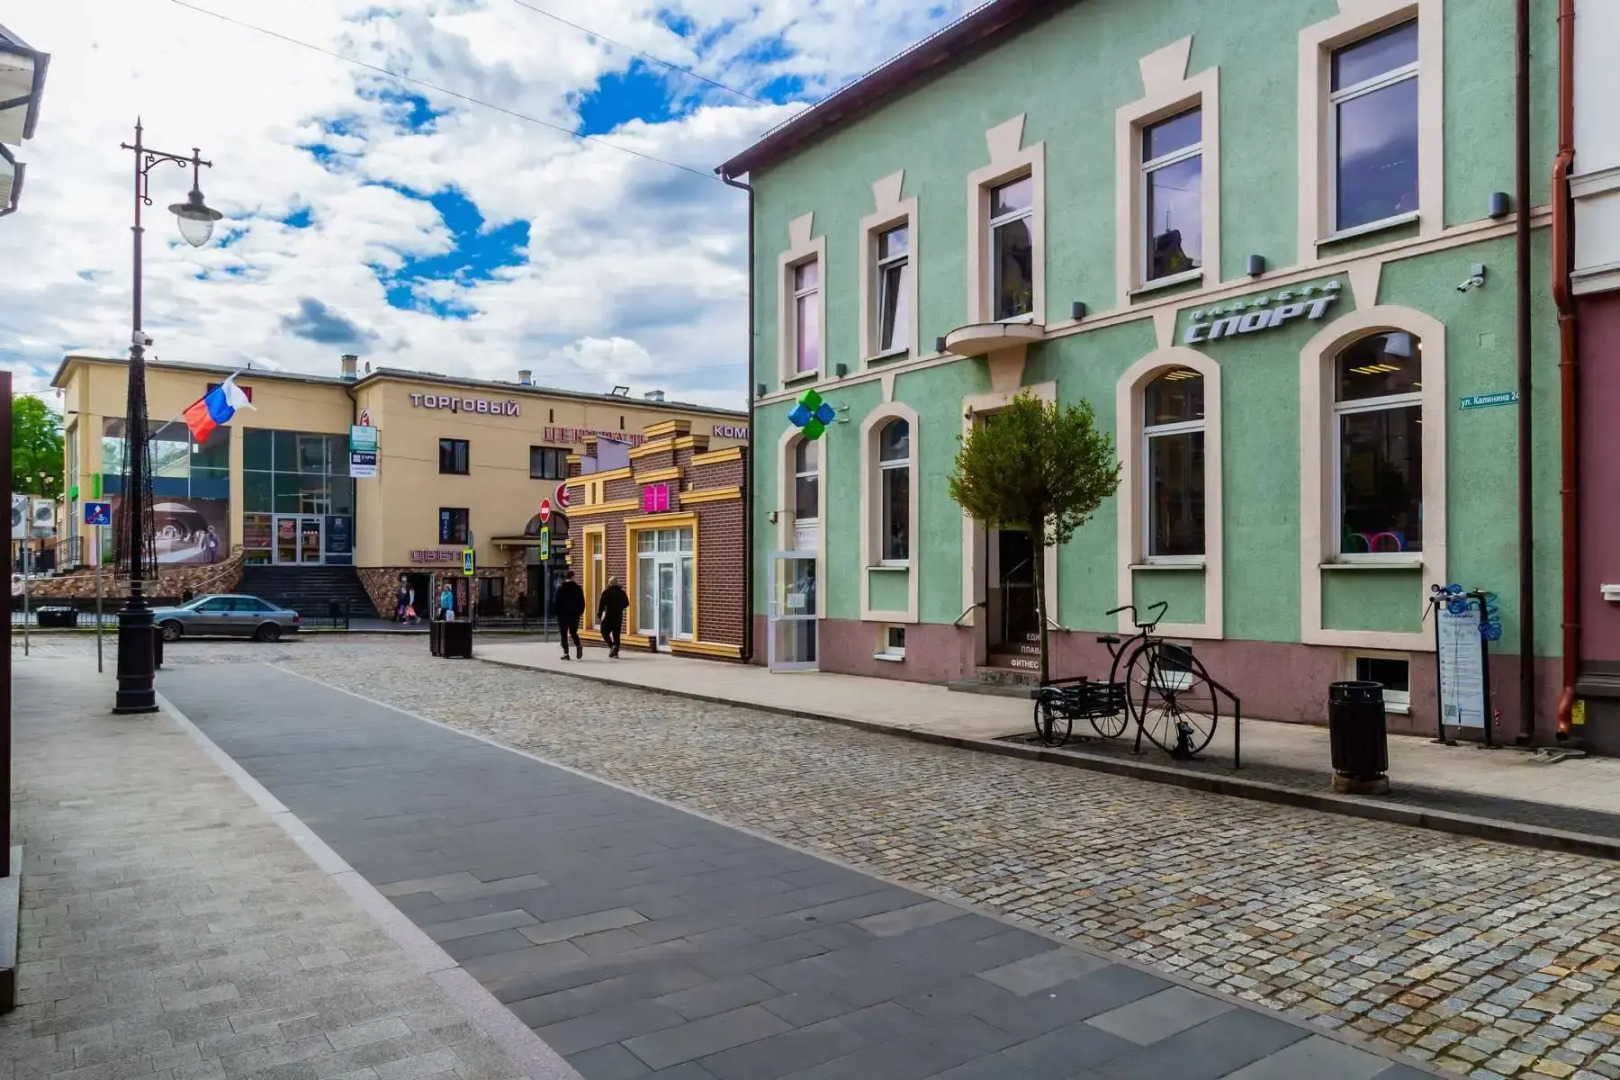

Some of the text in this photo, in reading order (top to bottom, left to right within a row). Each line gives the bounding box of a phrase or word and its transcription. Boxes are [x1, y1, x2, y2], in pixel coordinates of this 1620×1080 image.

[1190, 280, 1341, 320] ПЛАНЕТА
[1183, 294, 1338, 344] СПОРТ
[409, 392, 520, 417] ТОРГОВЫЙ
[1474, 395, 1510, 405] Калинина
[1021, 645, 1042, 654] ПЛАВ
[1011, 659, 1039, 669] ФИТНЕС
